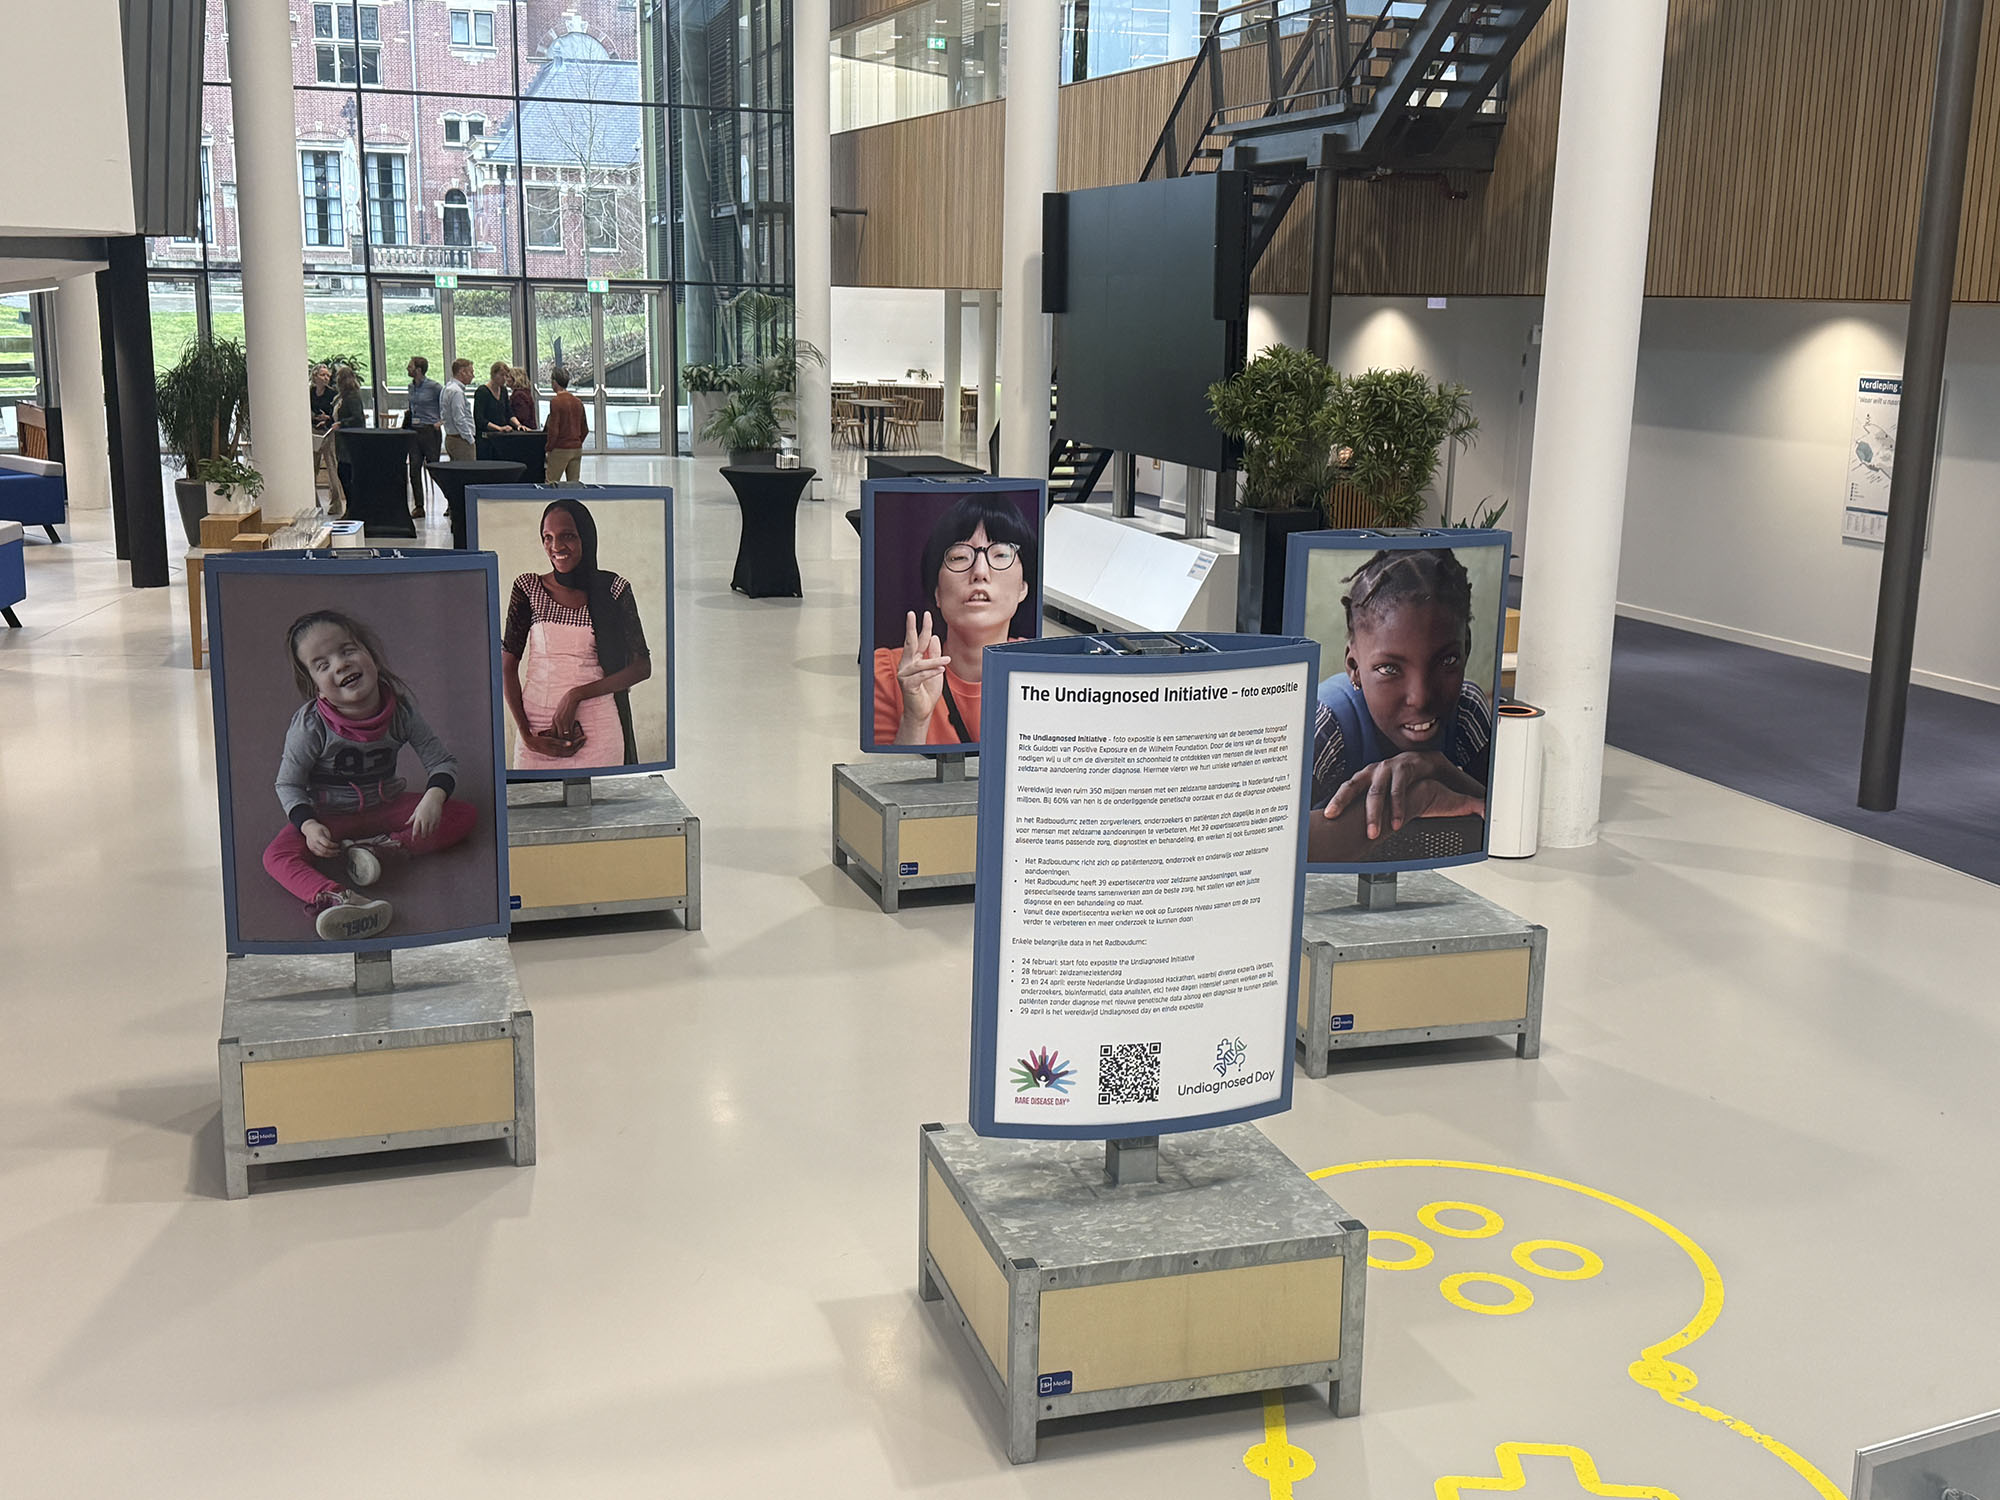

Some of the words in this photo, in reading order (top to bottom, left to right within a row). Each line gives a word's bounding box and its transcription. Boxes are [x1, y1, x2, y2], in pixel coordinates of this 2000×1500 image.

[1860, 380, 1898, 392] Verdieping
[1021, 686, 1049, 701] The
[1056, 686, 1159, 704] Undiagnosed
[1164, 686, 1228, 702] Initiative
[1241, 686, 1259, 698] foto
[1262, 682, 1298, 696] expositie
[1033, 734, 1076, 743] Undiagnosed
[1128, 735, 1154, 744] expositie
[1033, 744, 1058, 752] Guidotti
[1099, 745, 1128, 754] Exposure
[1018, 754, 1044, 763] nodigen
[1046, 755, 1055, 764] wij
[1050, 766, 1086, 775] aandoening
[1018, 785, 1053, 794] Wereldwijd
[1055, 786, 1071, 794] leven
[1104, 787, 1126, 796] miljoen
[1053, 796, 1068, 804] 60%
[1036, 817, 1077, 825] Radboudumc
[1103, 828, 1146, 836] aandoeningen
[1066, 838, 1095, 846] passende
[1114, 837, 1148, 846] diagnostiek
[1038, 858, 1079, 866] Radboudumc
[1037, 878, 1079, 886] Radboudumc
[1108, 878, 1155, 887] expertisecentra
[1024, 888, 1075, 896] gespecialiseerde
[1098, 888, 1140, 896] samenwerken
[1024, 897, 1052, 906] diagnose
[1077, 898, 1115, 907] behandeling
[1045, 908, 1060, 916] deze
[1062, 909, 1109, 917] expertisecentra
[1116, 918, 1146, 926] onderzoek
[1012, 937, 1032, 945] Enkele
[1034, 938, 1068, 947] belangrijke
[1076, 958, 1088, 966] foto
[1090, 959, 1117, 967] expositie
[1088, 978, 1125, 986] Nederlandse
[1072, 999, 1100, 1007] diagnose
[1031, 1008, 1044, 1016] april
[1064, 1008, 1098, 1017] wereldwijd
[1100, 1007, 1139, 1016] Undiagnosed
[1178, 1073, 1254, 1096] Undiagnosed
[1255, 1070, 1275, 1082] Day
[1014, 1096, 1030, 1104] RARE
